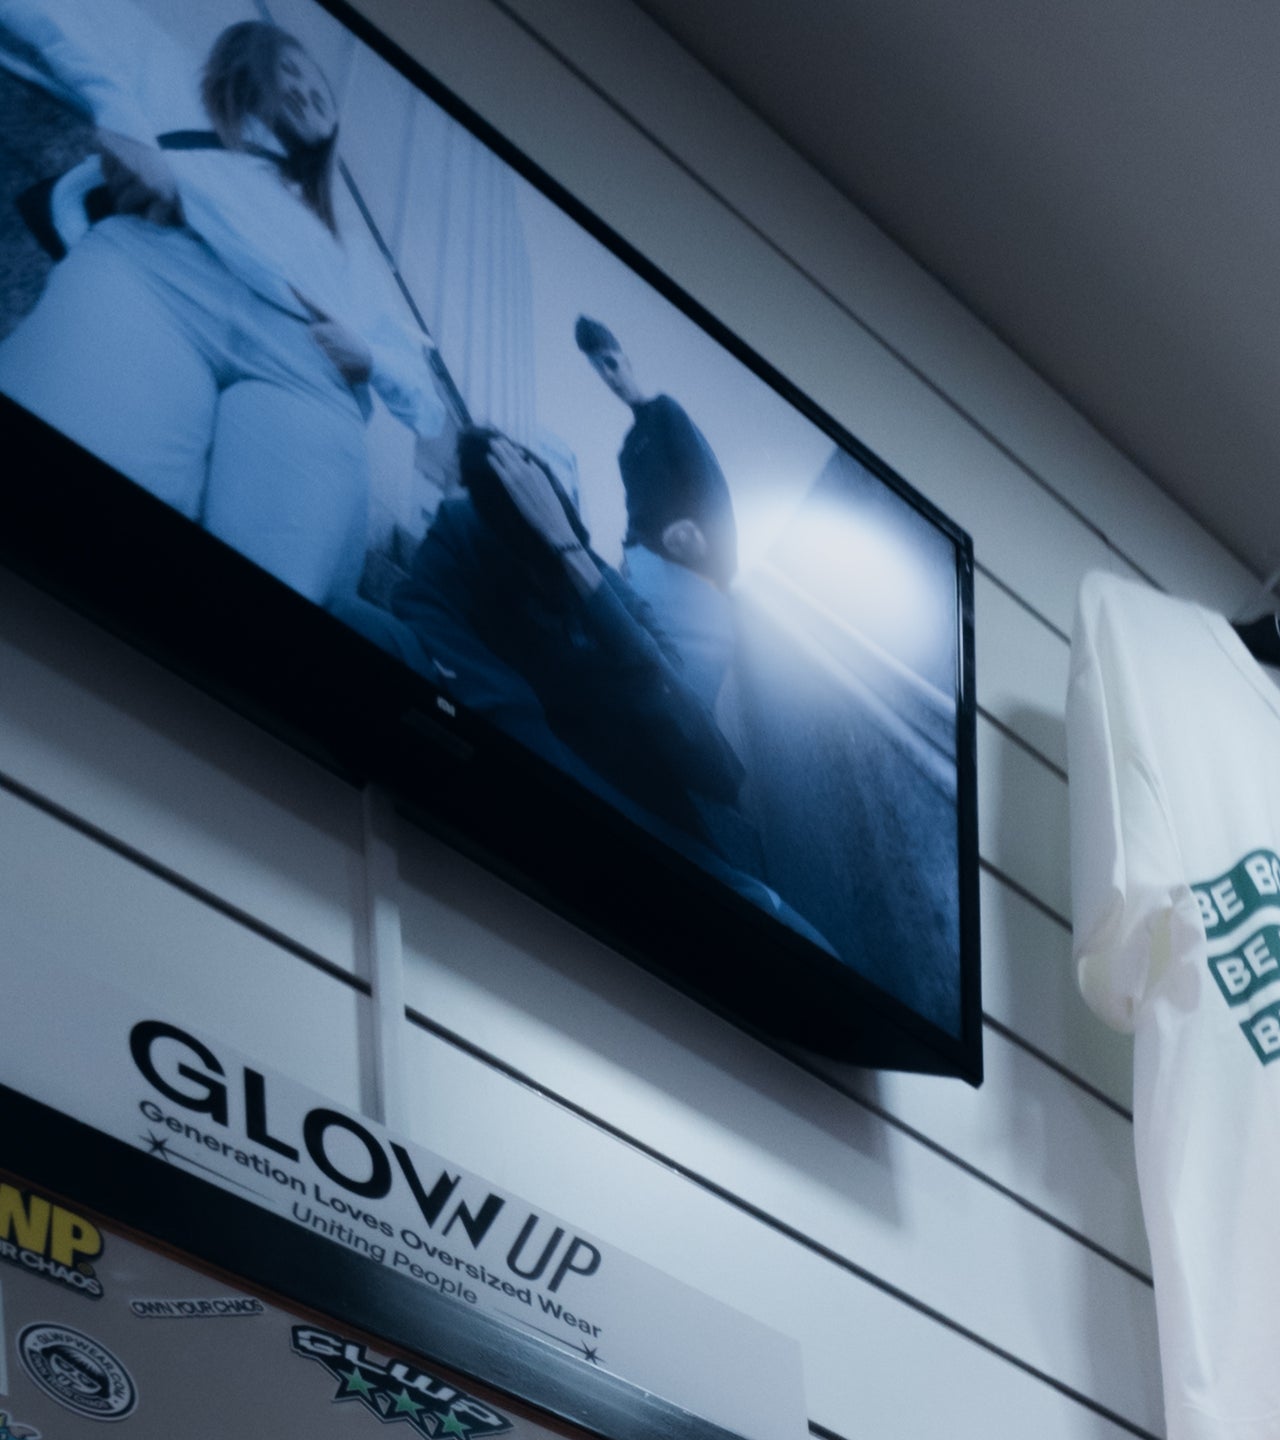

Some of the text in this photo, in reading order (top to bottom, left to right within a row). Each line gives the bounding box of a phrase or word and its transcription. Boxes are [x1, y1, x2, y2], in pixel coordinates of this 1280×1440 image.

[1216, 934, 1279, 996] BE
[138, 1099, 602, 1339] Generation Loves Oversized Wear
[291, 1201, 479, 1304] Uniting People
[505, 1212, 603, 1294] UP
[20, 1249, 102, 1297] CHAOS
